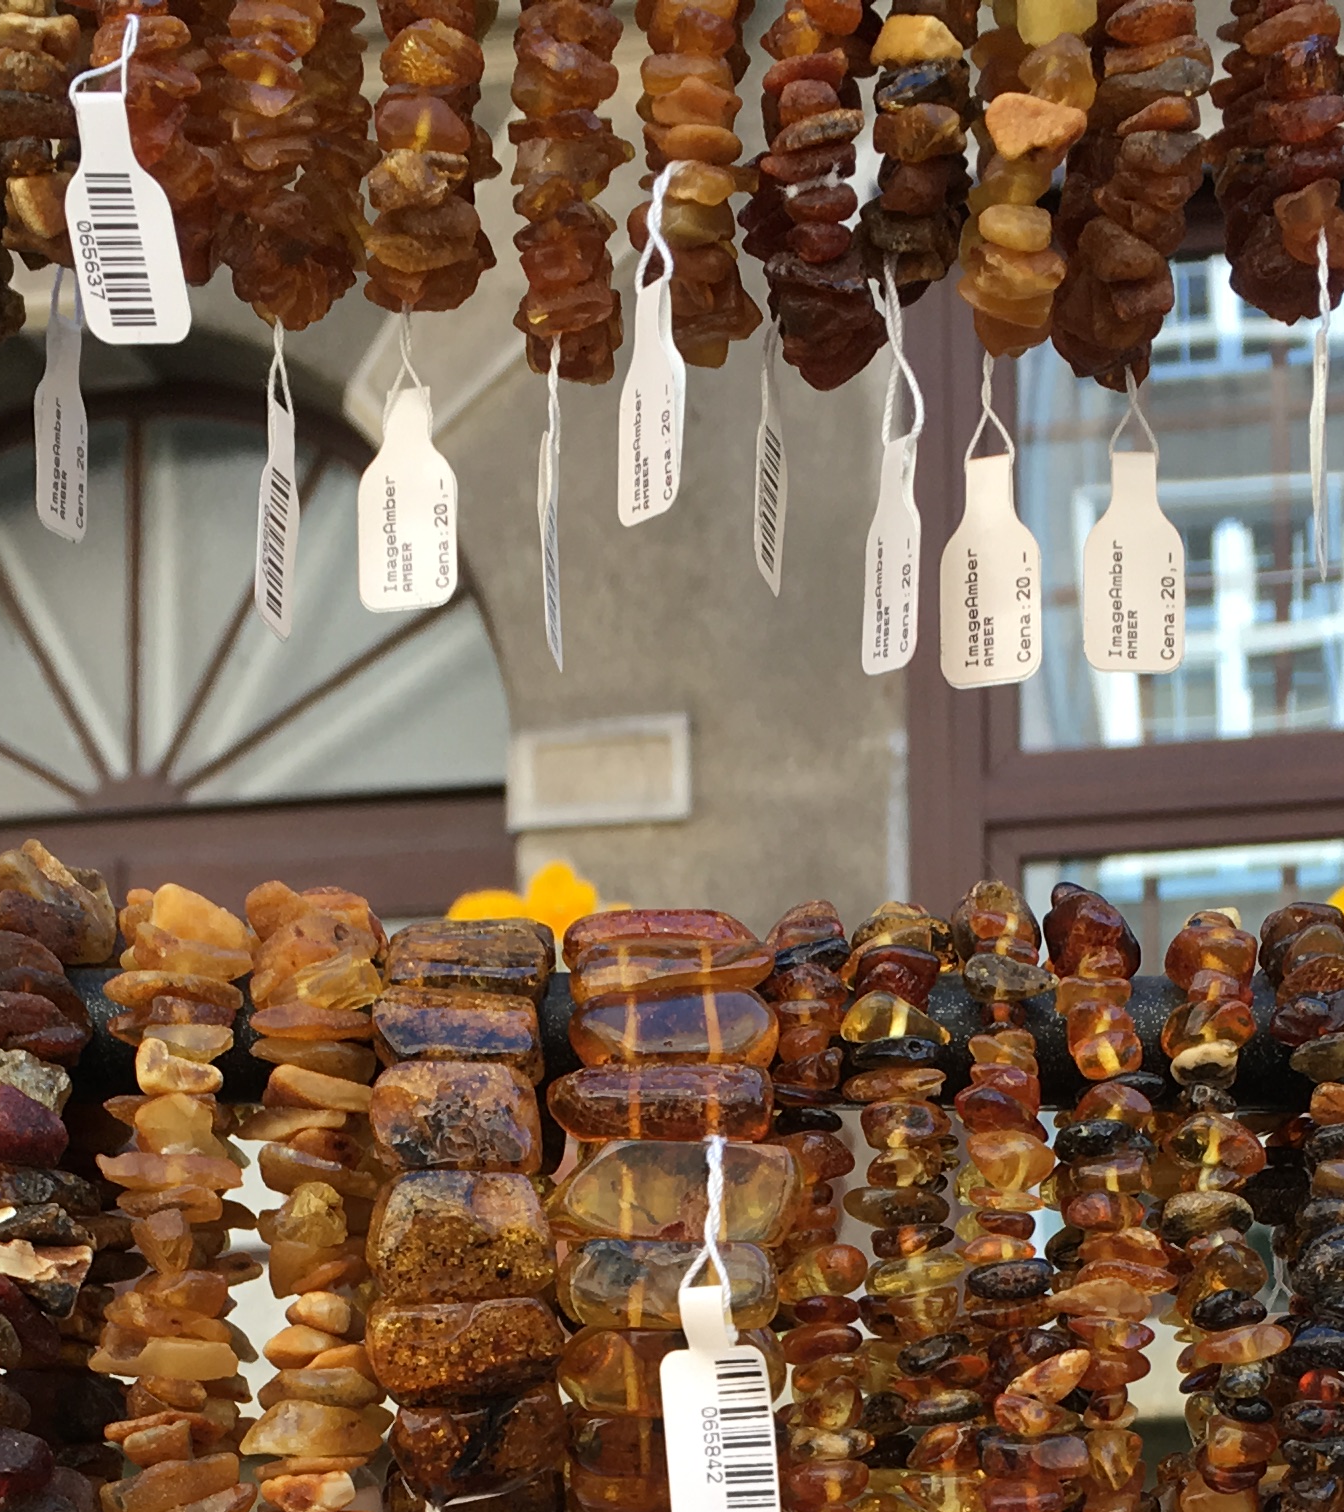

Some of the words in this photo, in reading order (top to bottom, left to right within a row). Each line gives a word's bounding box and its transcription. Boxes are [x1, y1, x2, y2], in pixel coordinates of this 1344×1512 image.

[76, 220, 106, 301] 065637
[51, 397, 64, 514] ImageAmber
[631, 387, 644, 513] ImageAmber
[641, 458, 650, 510] AMBER
[59, 470, 68, 520] AMBER
[382, 475, 396, 593] ImageAmber
[403, 541, 413, 591] AMBER
[873, 535, 886, 660] ImageAmber
[1108, 540, 1123, 659] ImageAmber
[881, 605, 890, 658] AMBER
[965, 549, 978, 669] ImageAmber
[985, 616, 994, 667] AMBER
[1127, 608, 1138, 660] AMBER
[700, 1405, 723, 1485] 065842
